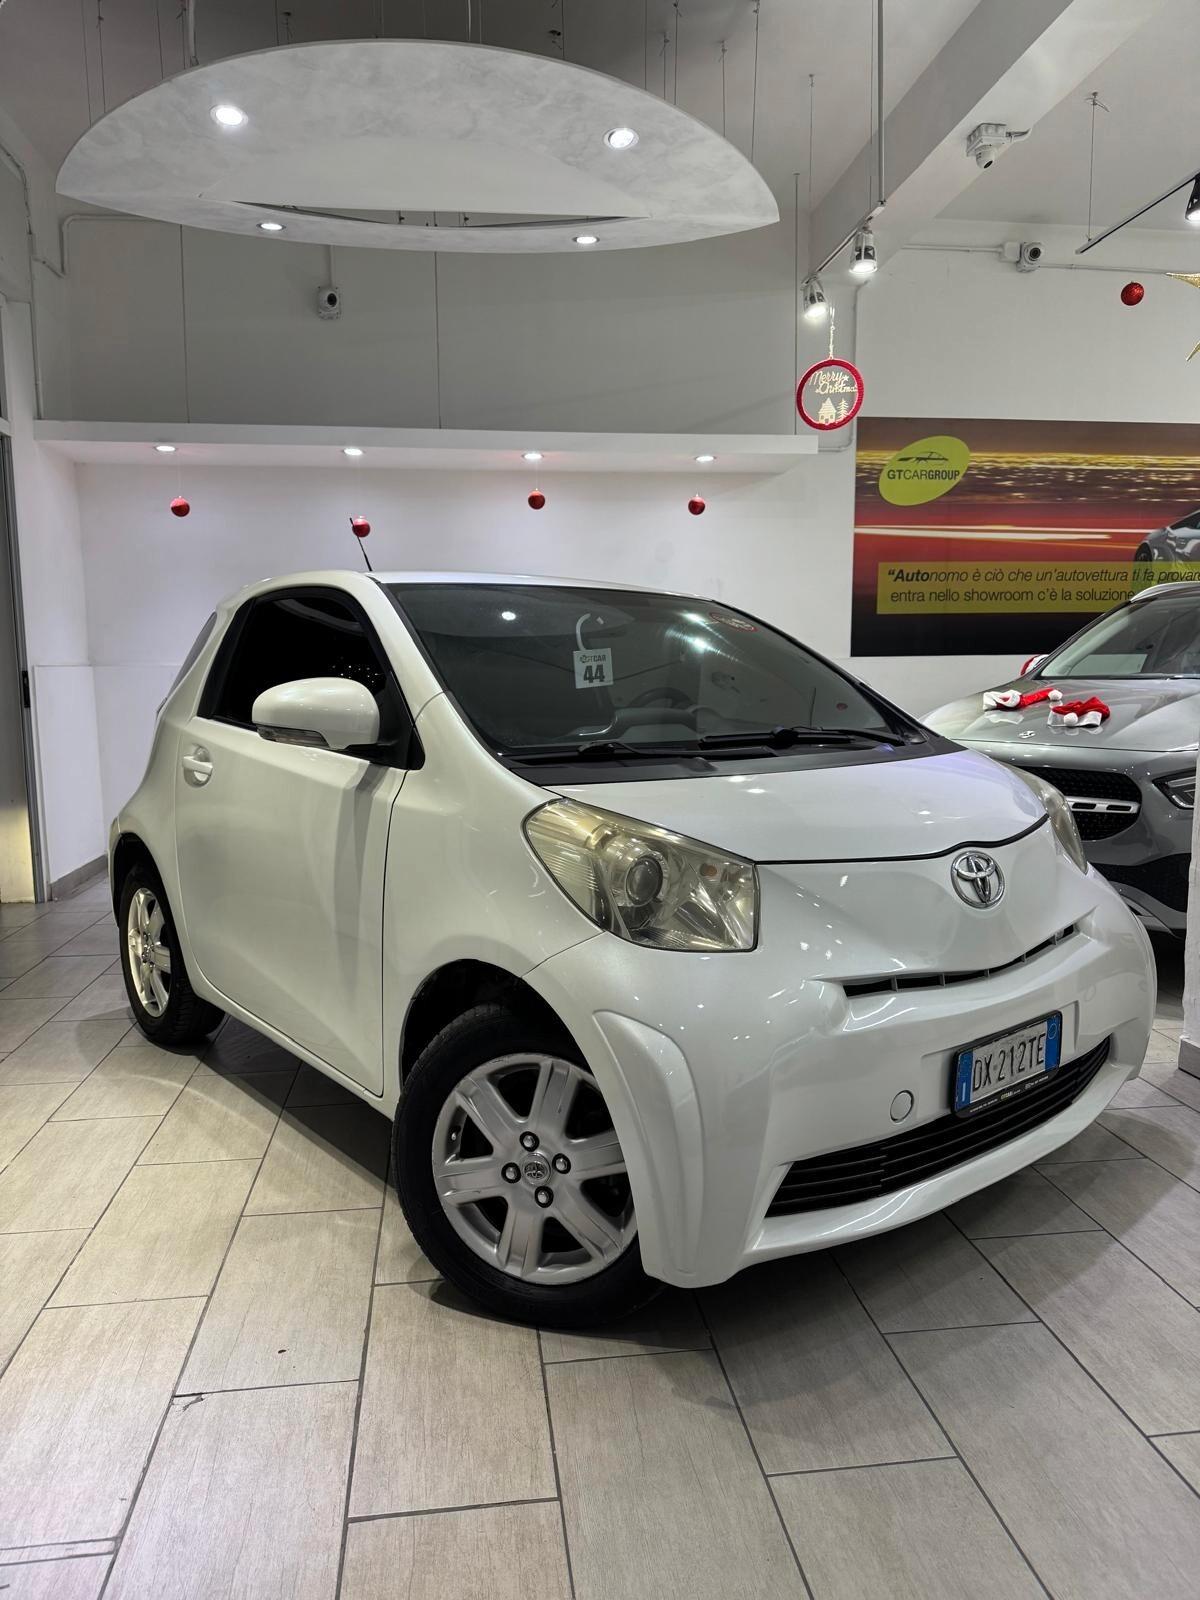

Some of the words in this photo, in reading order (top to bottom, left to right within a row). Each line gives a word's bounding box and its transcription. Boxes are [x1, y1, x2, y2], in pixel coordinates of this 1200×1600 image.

[809, 370, 843, 386] Merry
[887, 469, 960, 480] GTCARGROUP
[972, 568, 981, 582] è
[984, 568, 1005, 582] ciò
[1007, 568, 1033, 582] che
[1143, 568, 1154, 581] fa
[890, 590, 925, 602] entra
[929, 588, 960, 602] nello
[963, 588, 1034, 601] showroom
[1037, 588, 1058, 601] c'è
[1061, 588, 1072, 601] la
[1075, 588, 1135, 601] soluzione
[583, 664, 606, 683] 44
